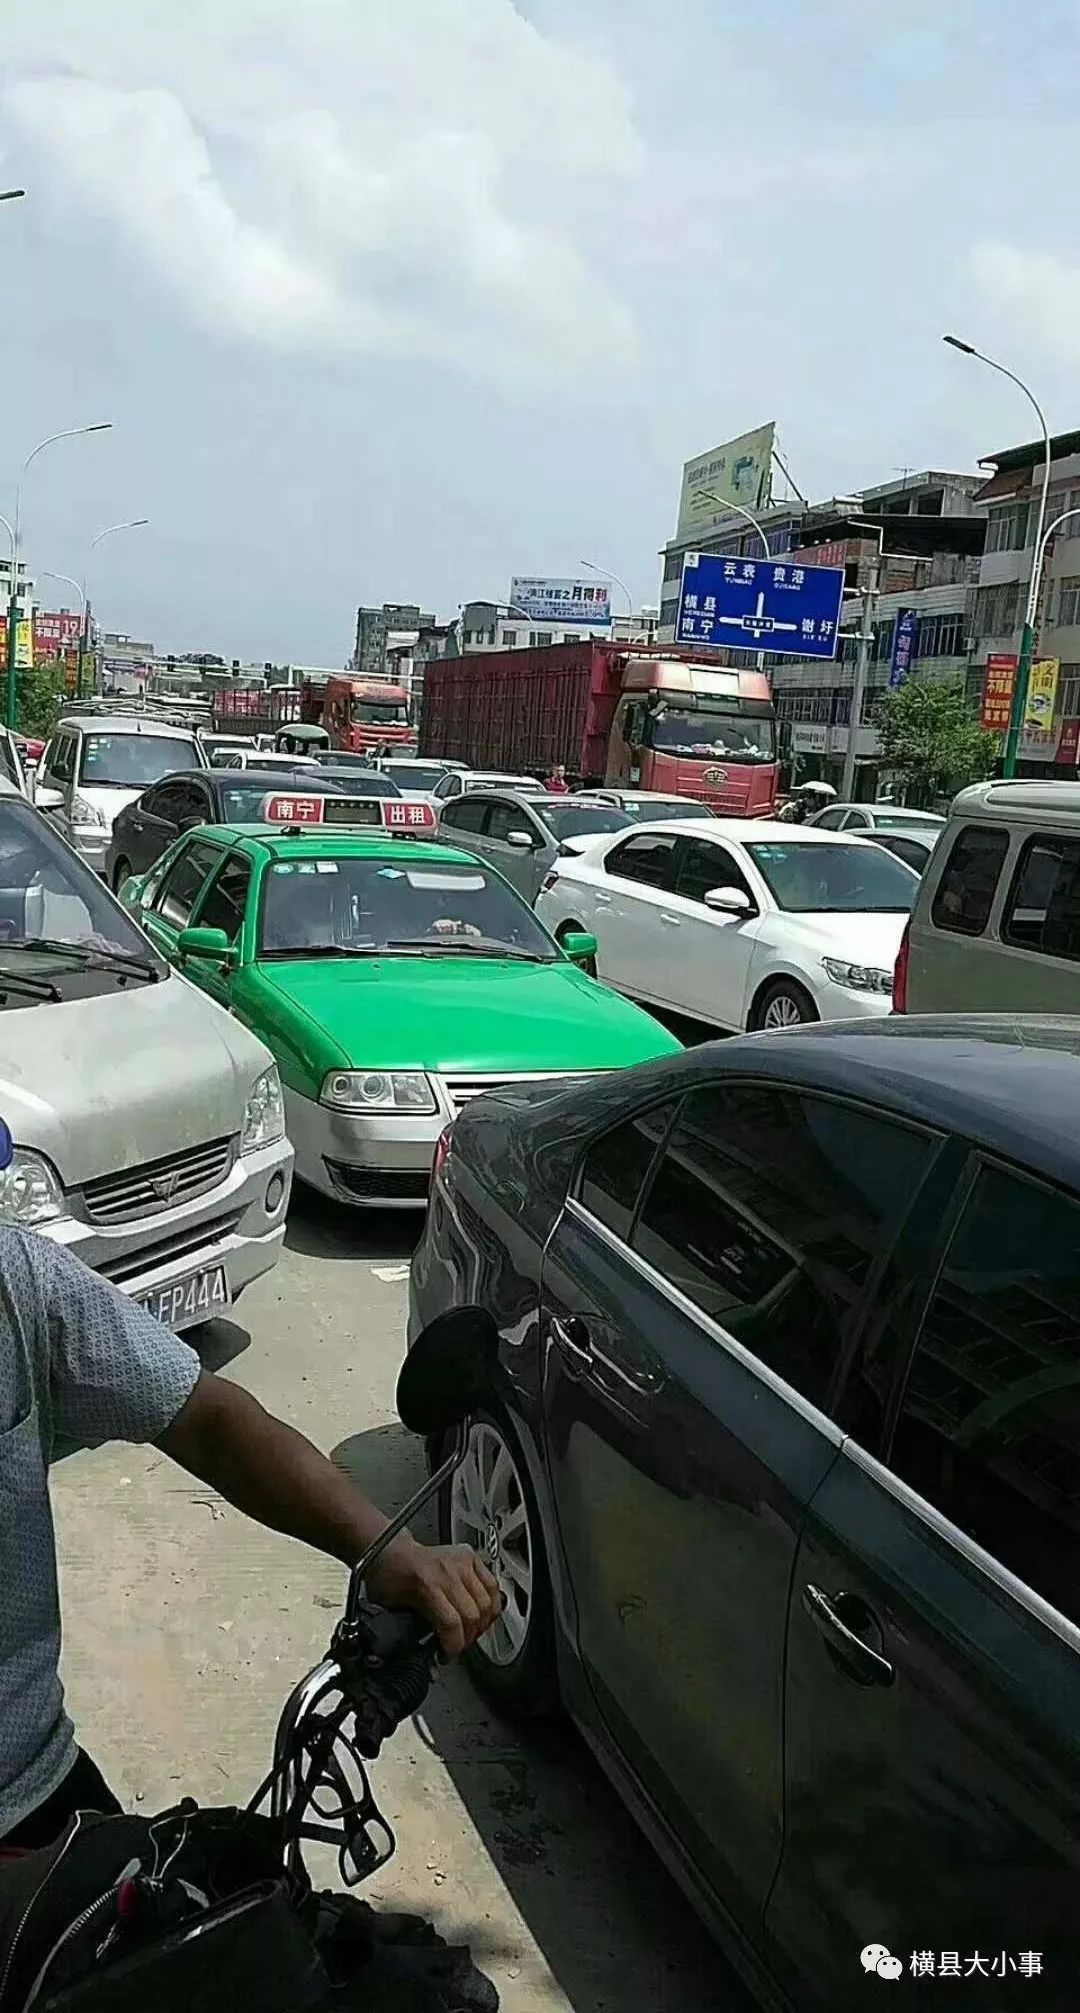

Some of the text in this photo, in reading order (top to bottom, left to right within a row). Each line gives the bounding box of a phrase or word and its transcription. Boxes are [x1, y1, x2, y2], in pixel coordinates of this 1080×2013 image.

[724, 562, 805, 584] 云表 贵港
[684, 593, 717, 611] 横县
[681, 617, 714, 634] 南宁
[276, 801, 425, 824] 南宁 出租
